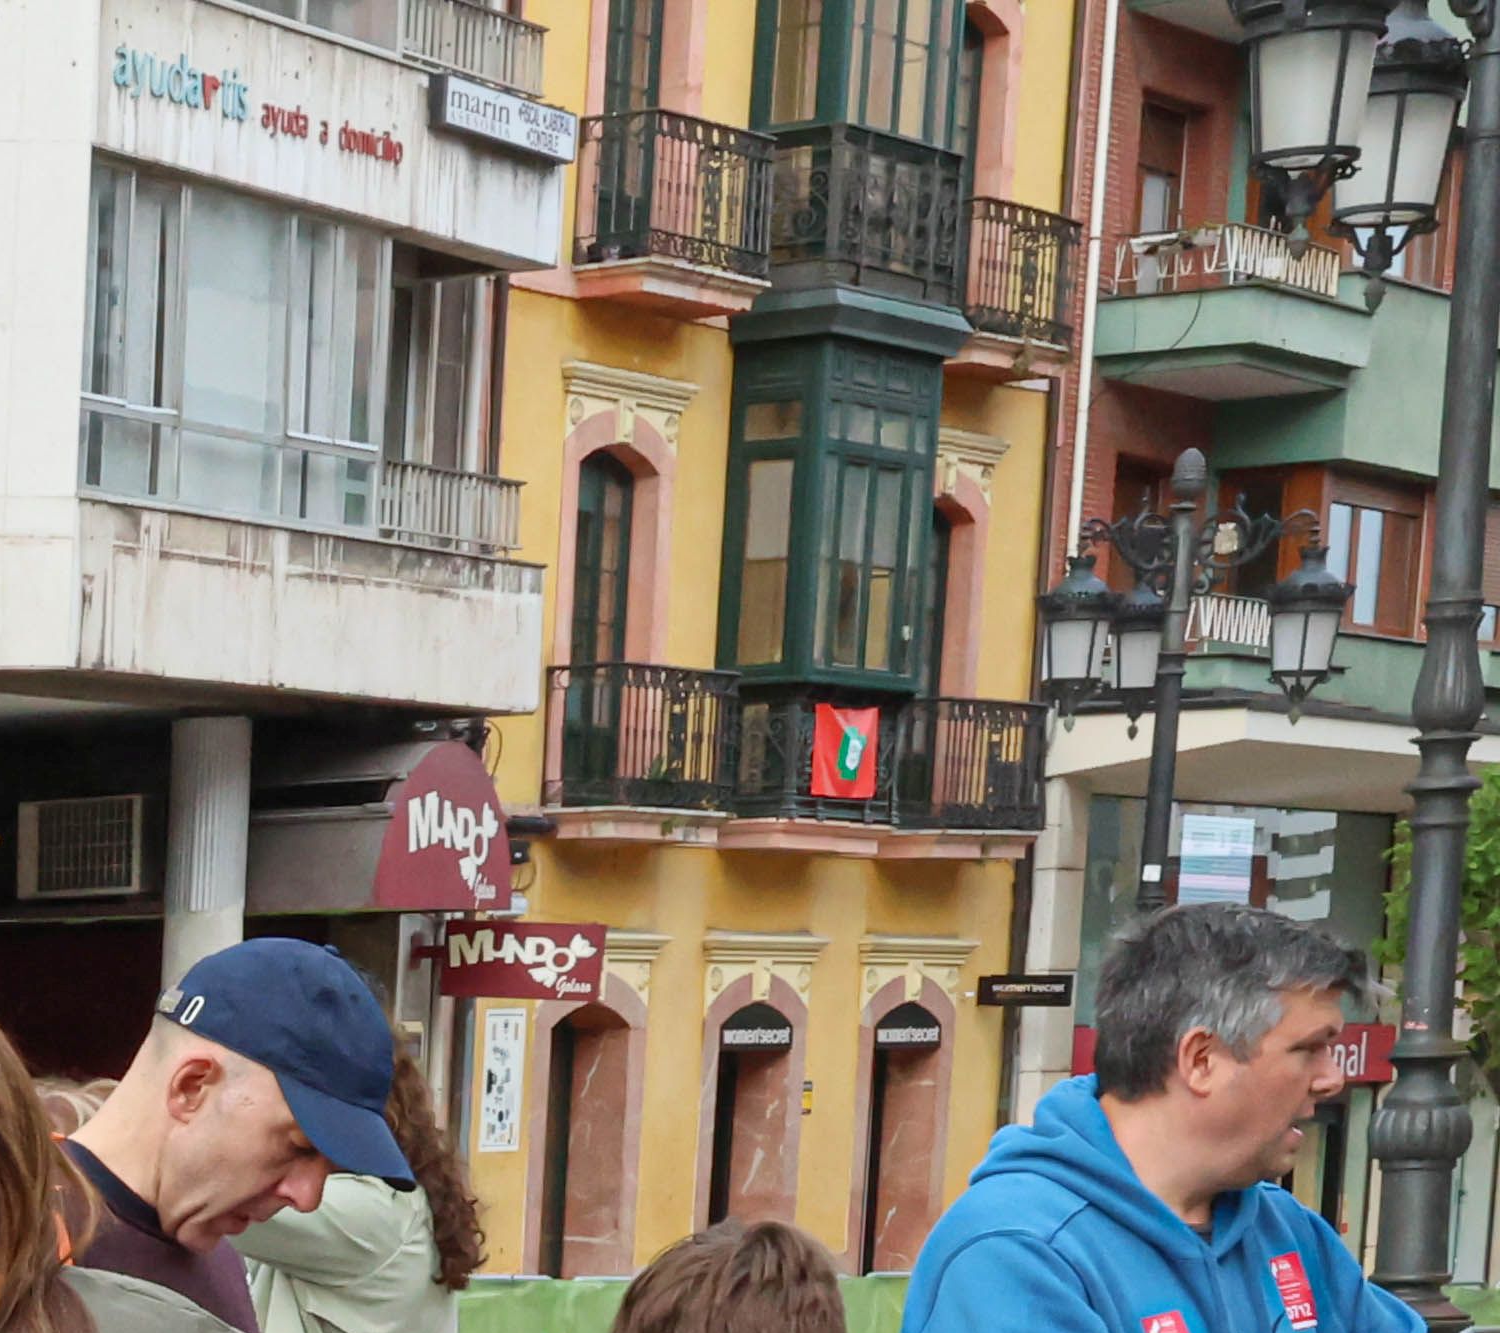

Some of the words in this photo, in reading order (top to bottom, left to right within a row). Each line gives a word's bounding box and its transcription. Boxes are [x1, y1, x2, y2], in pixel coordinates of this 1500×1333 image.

[113, 43, 250, 121] ayudartis
[262, 102, 308, 141] ayuda
[320, 120, 329, 145] a
[338, 120, 404, 165] domicilio
[723, 1025, 791, 1045] women'secret
[876, 1025, 940, 1045] women'secret
[1332, 1031, 1368, 1077] nal
[1285, 1303, 1313, 1321] 0712
